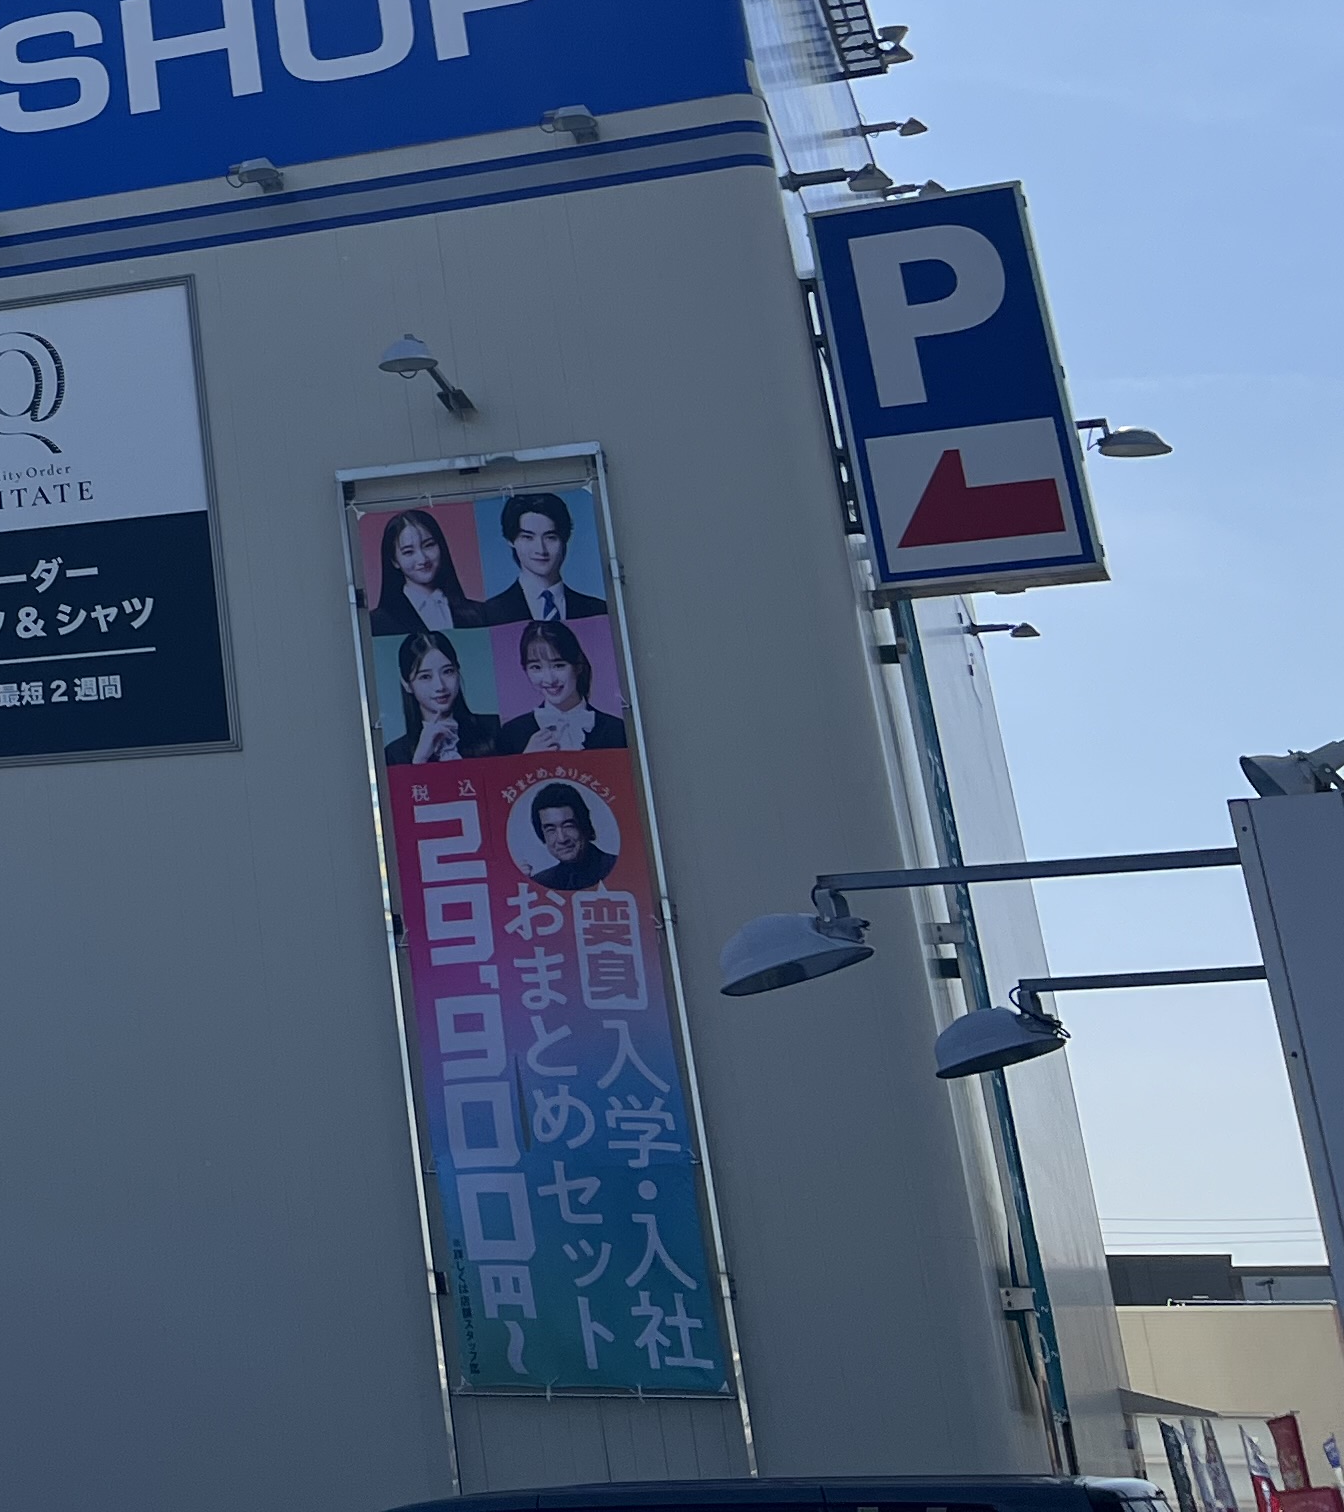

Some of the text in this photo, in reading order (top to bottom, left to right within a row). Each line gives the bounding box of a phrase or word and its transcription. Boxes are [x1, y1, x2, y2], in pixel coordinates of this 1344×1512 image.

[850, 225, 1005, 408] P
[25, 463, 72, 479] Order
[503, 883, 614, 1370] おまとめセット
